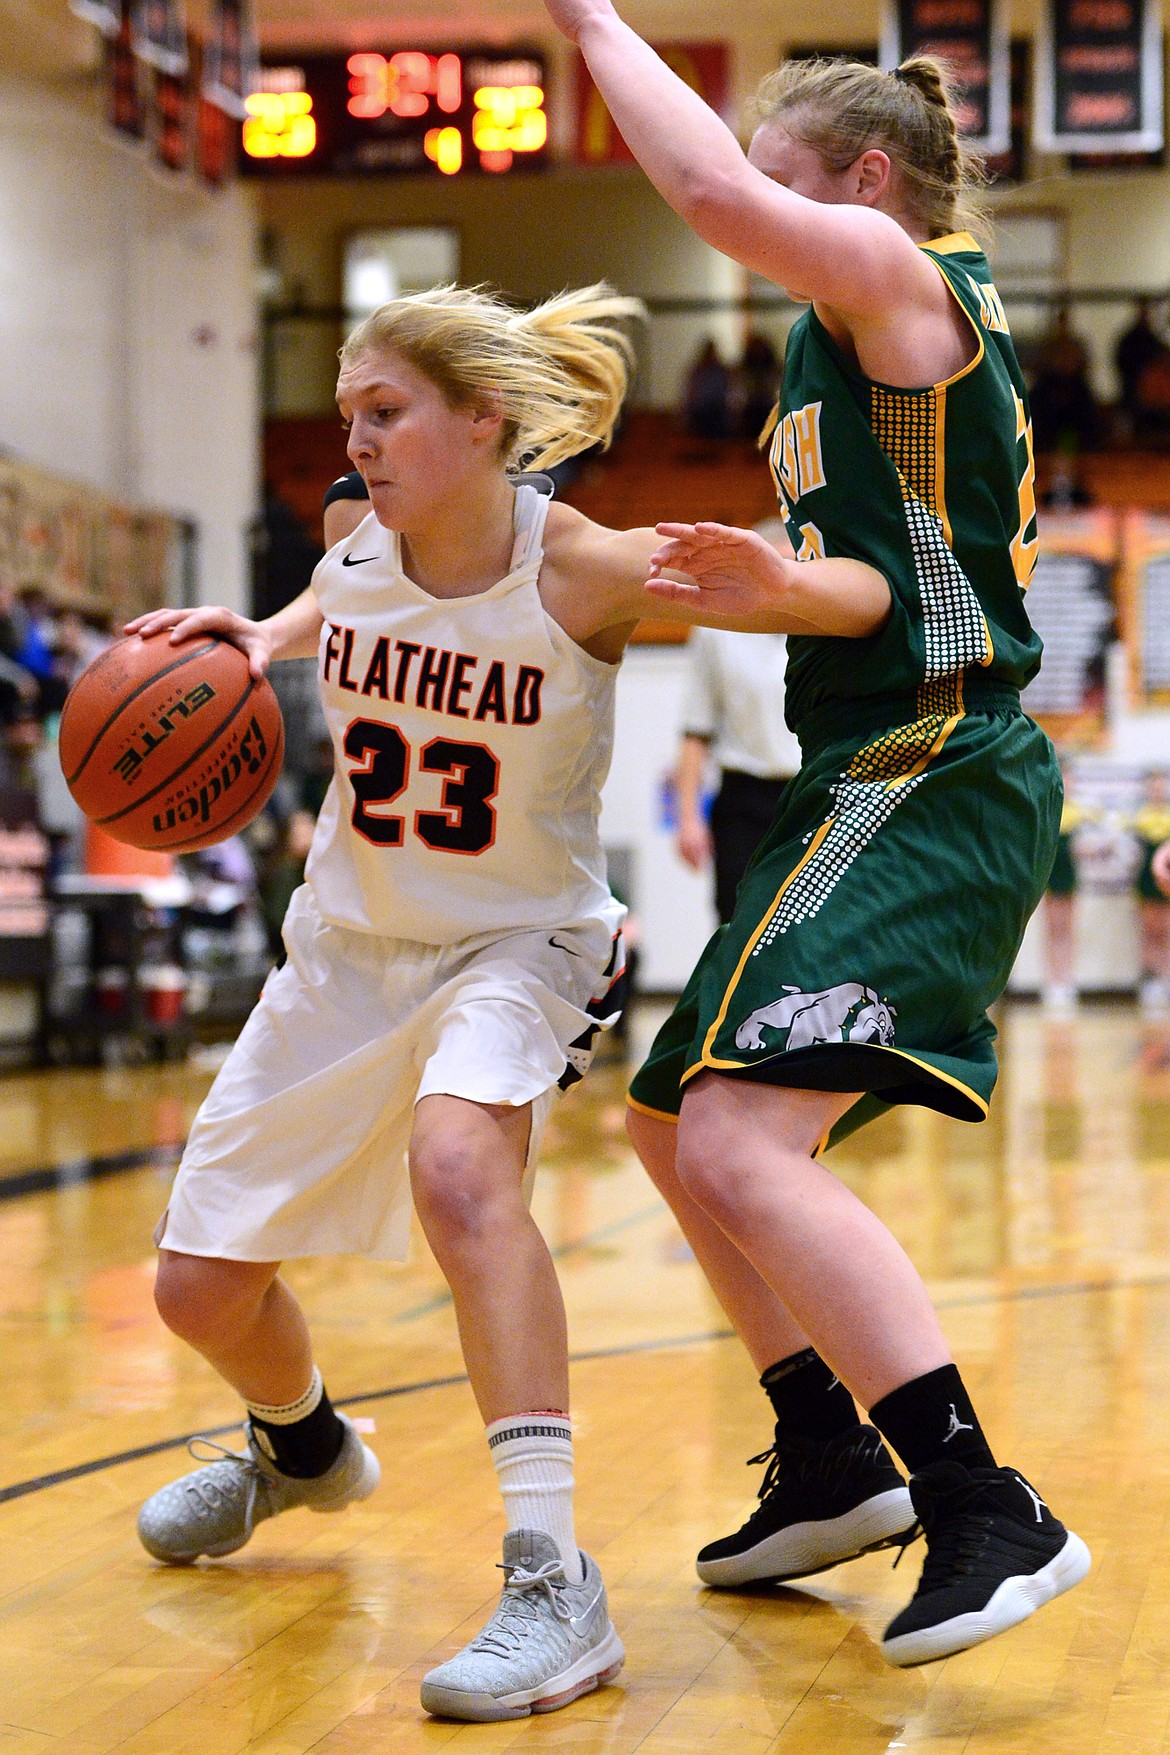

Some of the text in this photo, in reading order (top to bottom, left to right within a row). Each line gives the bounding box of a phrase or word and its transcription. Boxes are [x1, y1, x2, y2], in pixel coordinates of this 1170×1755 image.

[324, 623, 545, 727] FLATHEAD
[113, 682, 217, 781] ELITE
[152, 715, 268, 832] Baden
[343, 716, 501, 857] 23
